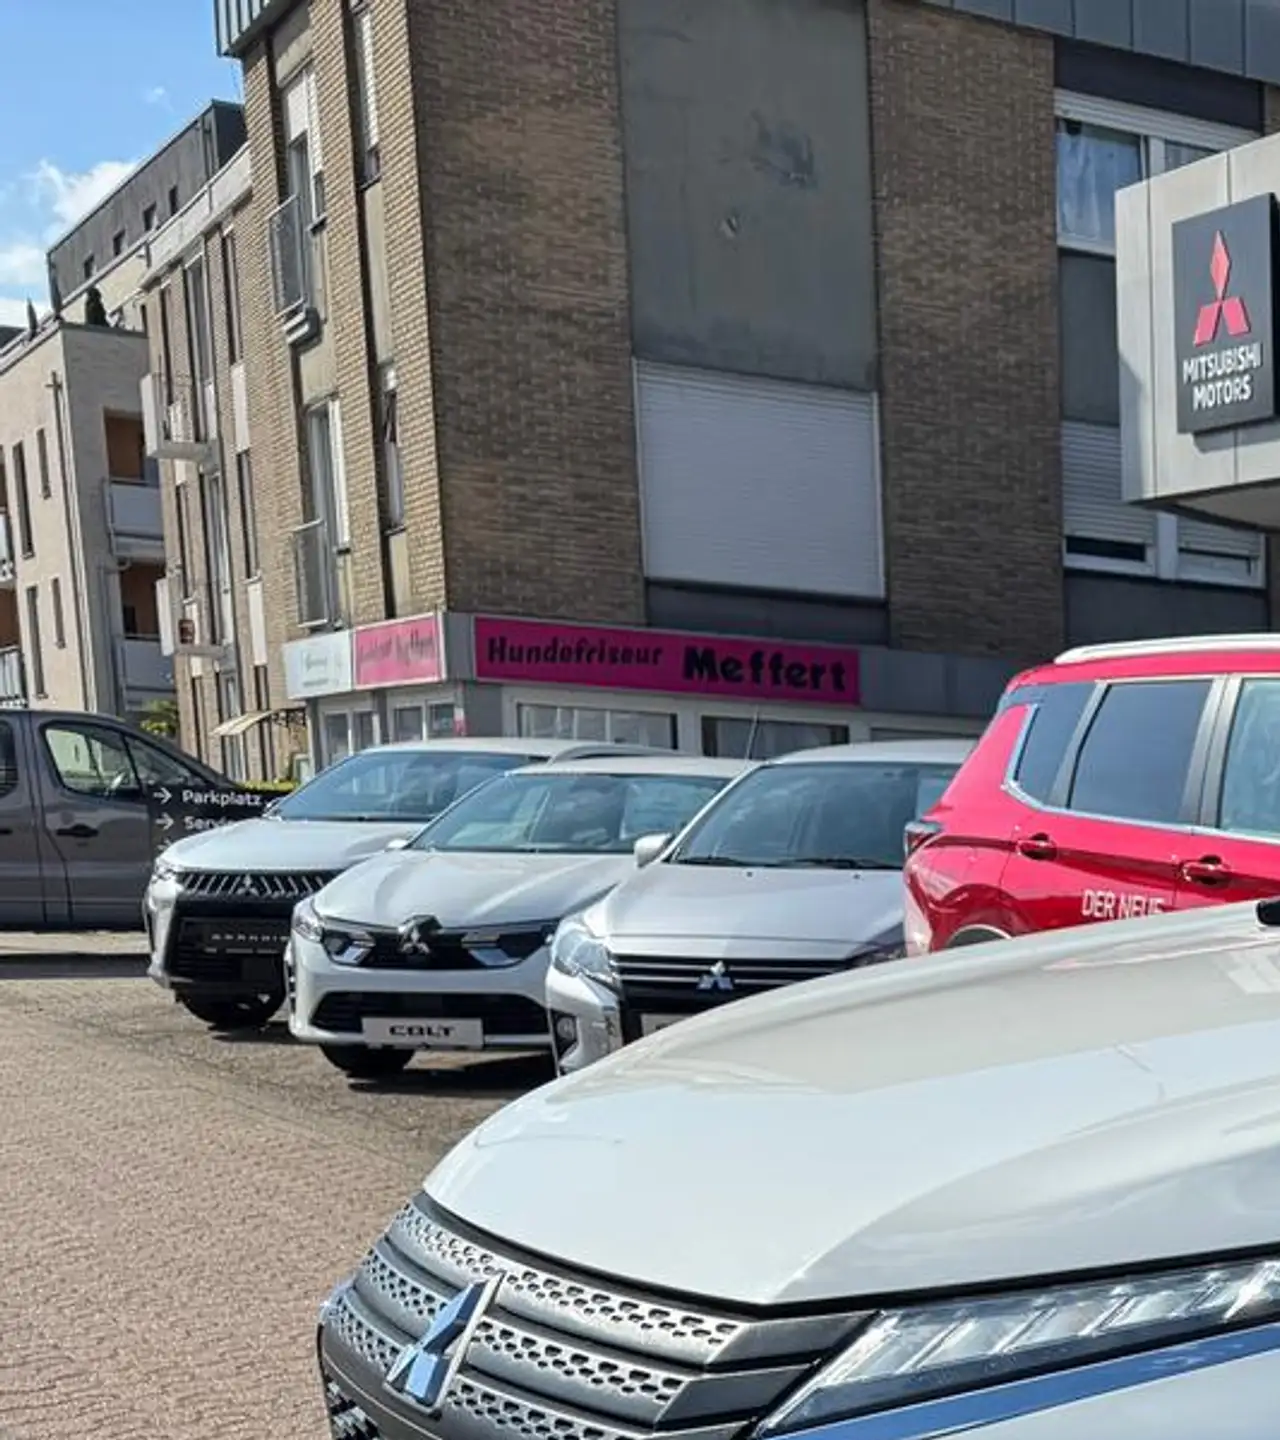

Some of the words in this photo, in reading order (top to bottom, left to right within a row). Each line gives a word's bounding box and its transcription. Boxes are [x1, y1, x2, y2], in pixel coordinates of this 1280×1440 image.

[1183, 341, 1263, 385] MITSUBISHI
[1192, 374, 1252, 412] MOTORS
[487, 637, 665, 667] Hundefriseur
[681, 645, 848, 692] Meffert
[181, 789, 262, 807] Parkplatz
[1081, 889, 1116, 919] DER
[389, 1023, 456, 1038] COLT
